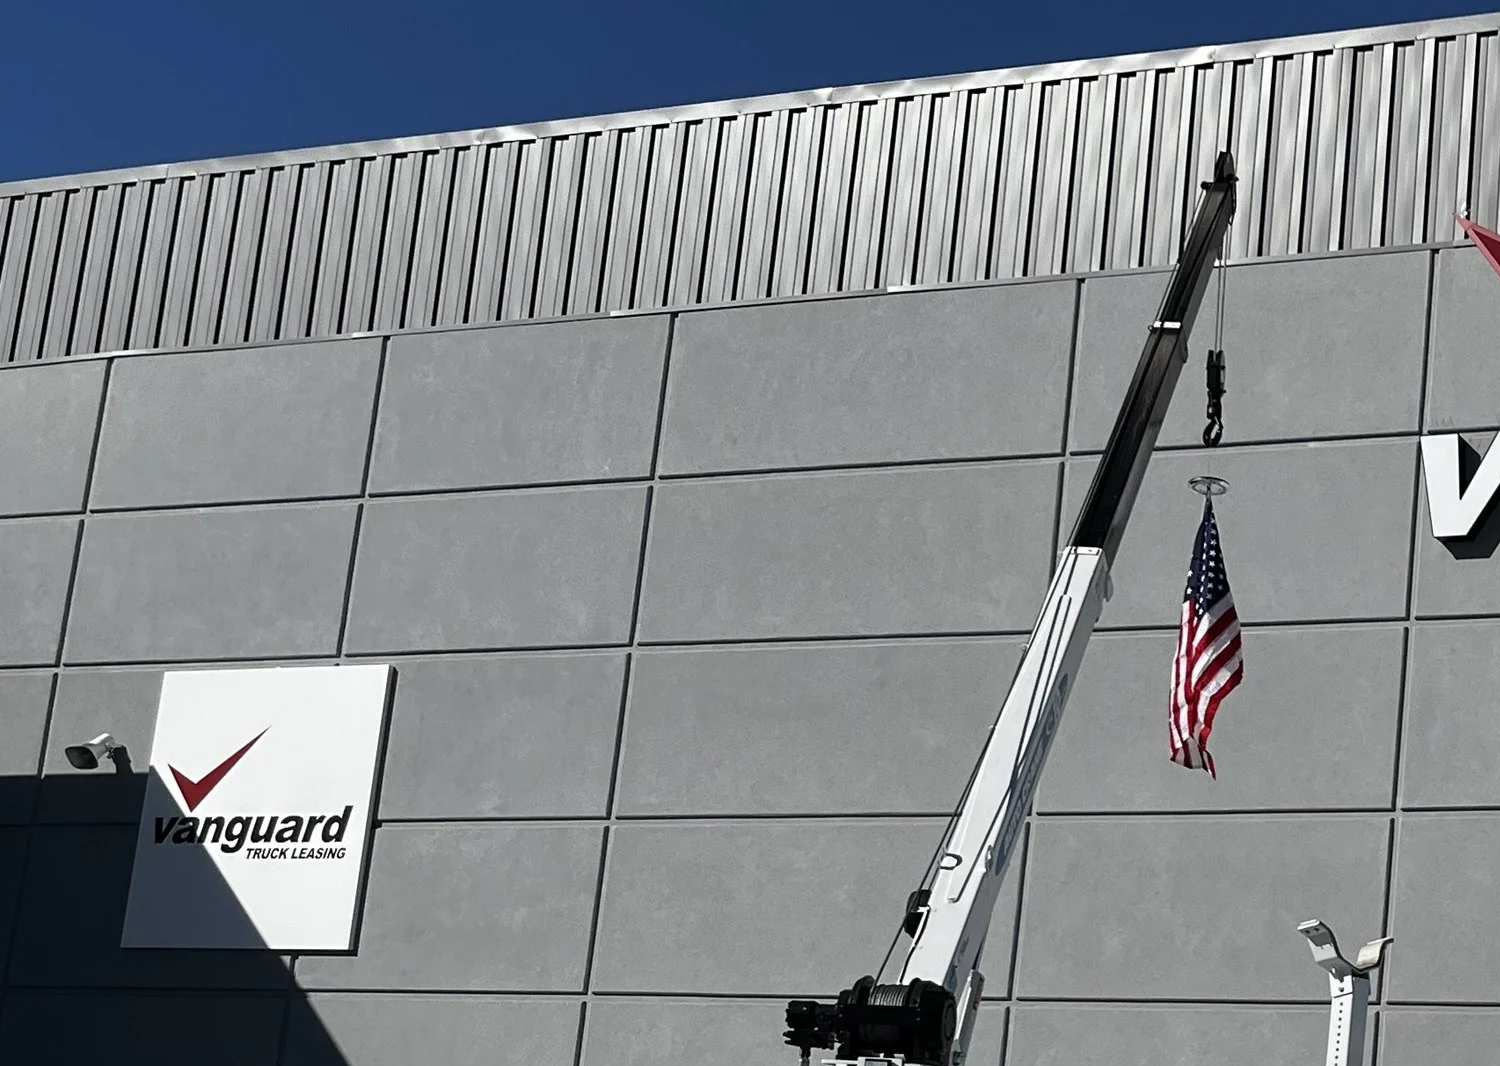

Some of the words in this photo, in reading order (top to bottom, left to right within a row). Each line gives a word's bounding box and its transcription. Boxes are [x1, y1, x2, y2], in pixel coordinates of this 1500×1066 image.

[154, 805, 354, 854] vanguard
[246, 848, 289, 859] TRUCK
[290, 847, 346, 859] LEASING
